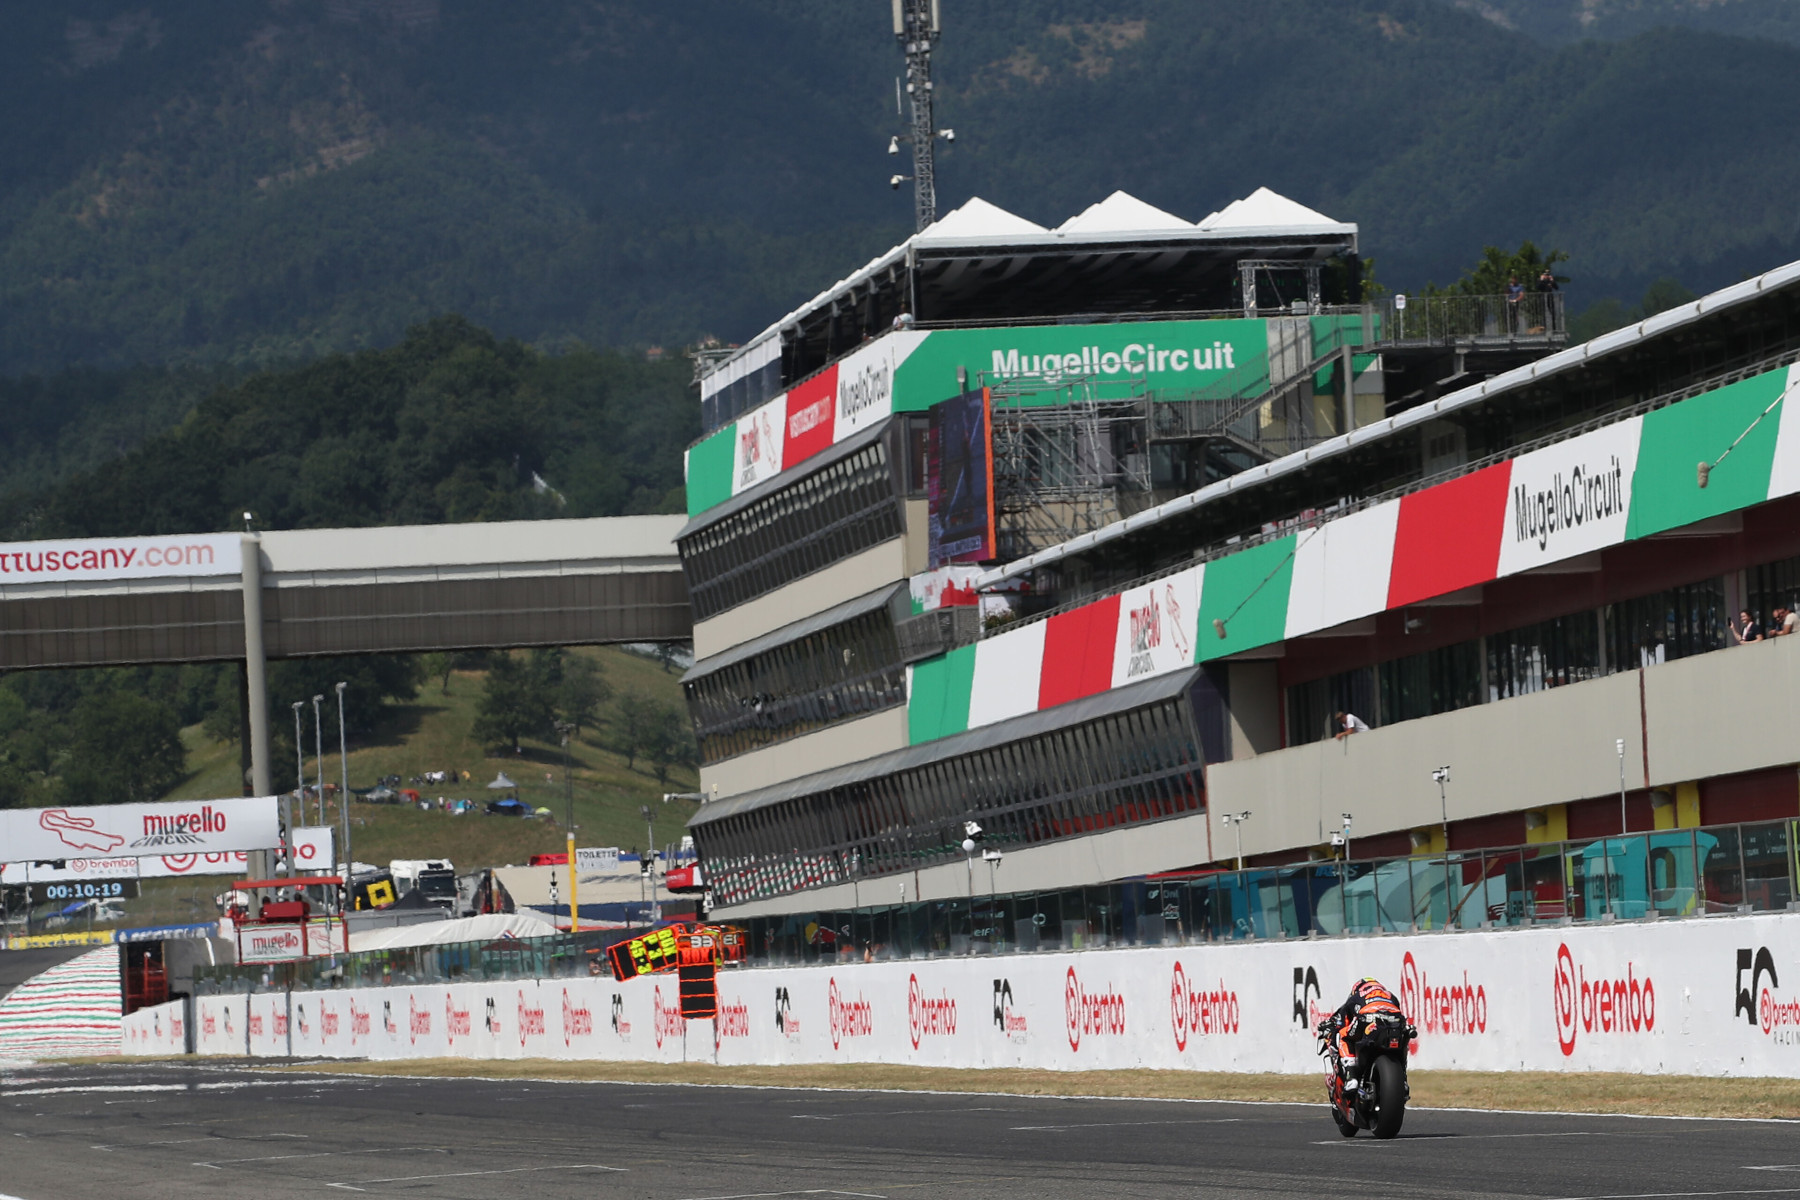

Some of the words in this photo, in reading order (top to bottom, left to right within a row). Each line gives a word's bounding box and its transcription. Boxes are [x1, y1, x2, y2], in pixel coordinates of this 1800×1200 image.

[992, 341, 1235, 383] MugelloCircuit
[1514, 455, 1623, 552] MugelloCircuit
[130, 834, 207, 848] CIRCUIT
[143, 806, 226, 835] mugello
[47, 883, 122, 899] 00:10:19
[838, 989, 872, 1037] brembo
[921, 987, 957, 1036] brembo
[1080, 981, 1126, 1035] brembo
[1188, 977, 1240, 1035] brembo
[1422, 969, 1487, 1034] brembo
[1580, 961, 1655, 1033] brembo
